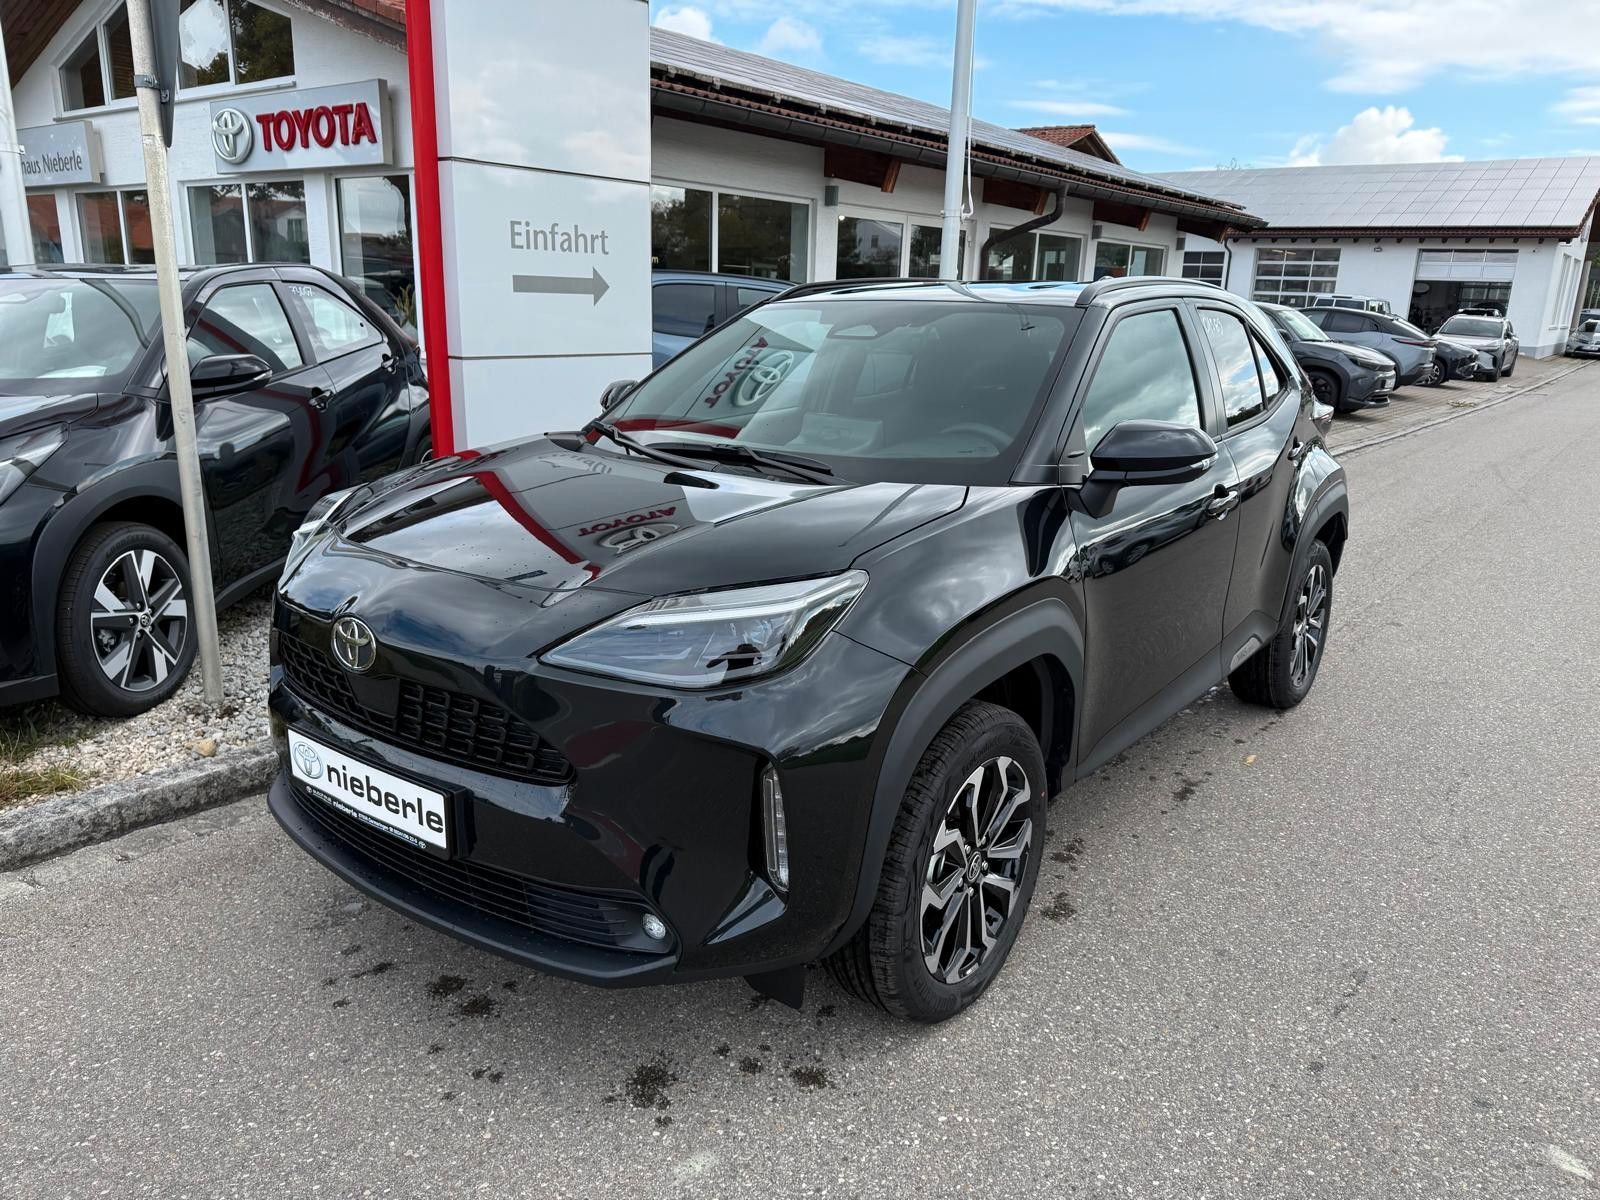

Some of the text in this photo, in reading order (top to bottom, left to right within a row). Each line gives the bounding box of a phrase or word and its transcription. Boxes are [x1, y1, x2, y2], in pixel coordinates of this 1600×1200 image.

[256, 103, 377, 152] TOYOTA
[42, 150, 83, 173] Nieberle
[510, 220, 609, 255] Einfahrt
[327, 764, 443, 834] nieberle
